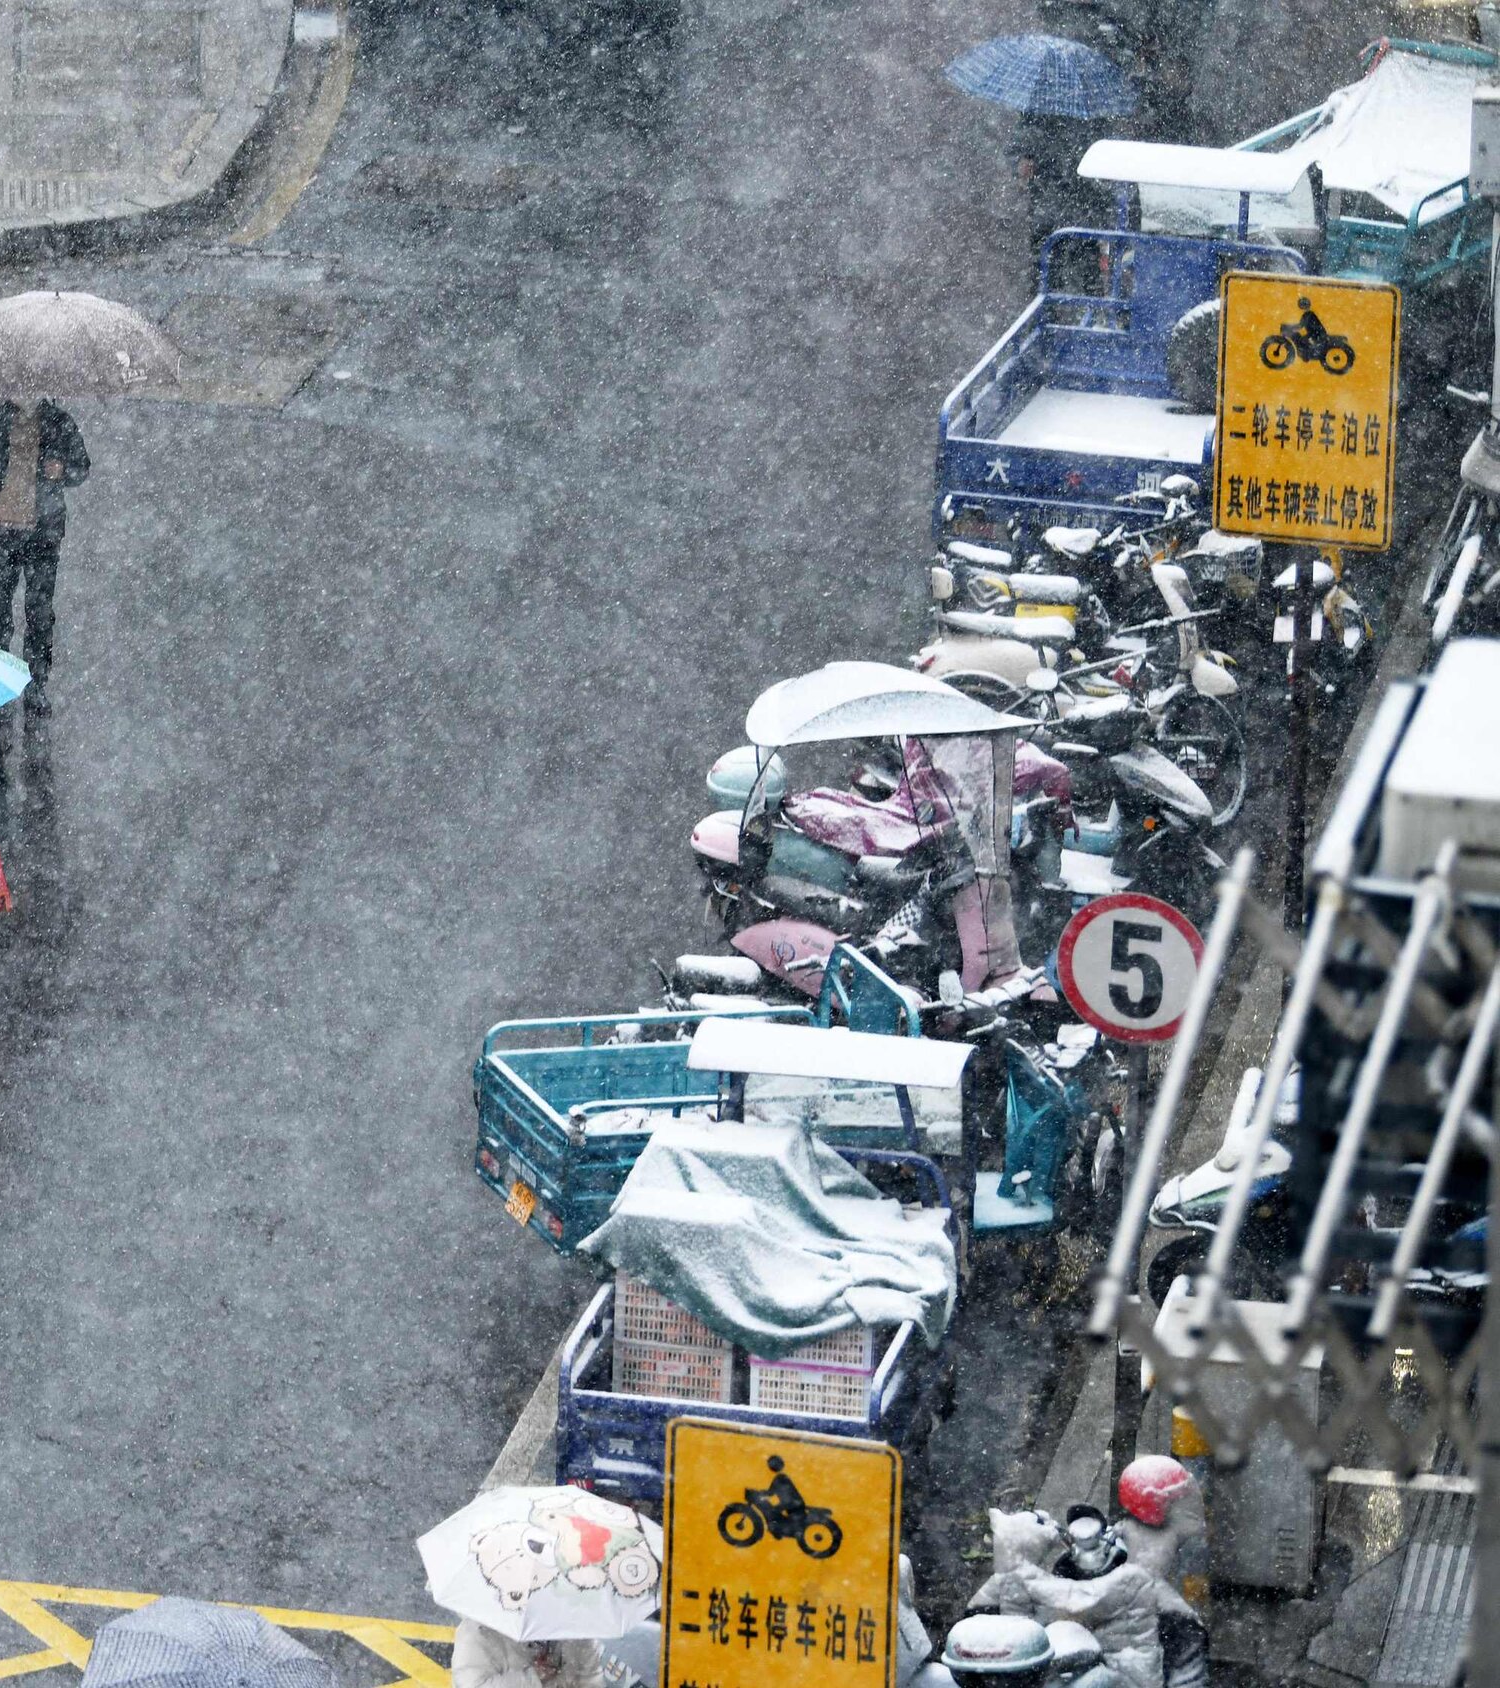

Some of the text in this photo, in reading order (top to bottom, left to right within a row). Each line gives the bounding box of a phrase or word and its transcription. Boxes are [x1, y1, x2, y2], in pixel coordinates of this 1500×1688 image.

[1229, 402, 1381, 458] 二轮车停车泊位
[985, 458, 1011, 484] 大
[1226, 474, 1379, 532] 其他车辆禁止停放
[1108, 919, 1164, 1020] 5
[678, 1587, 877, 1664] 二轮车停车泊位
